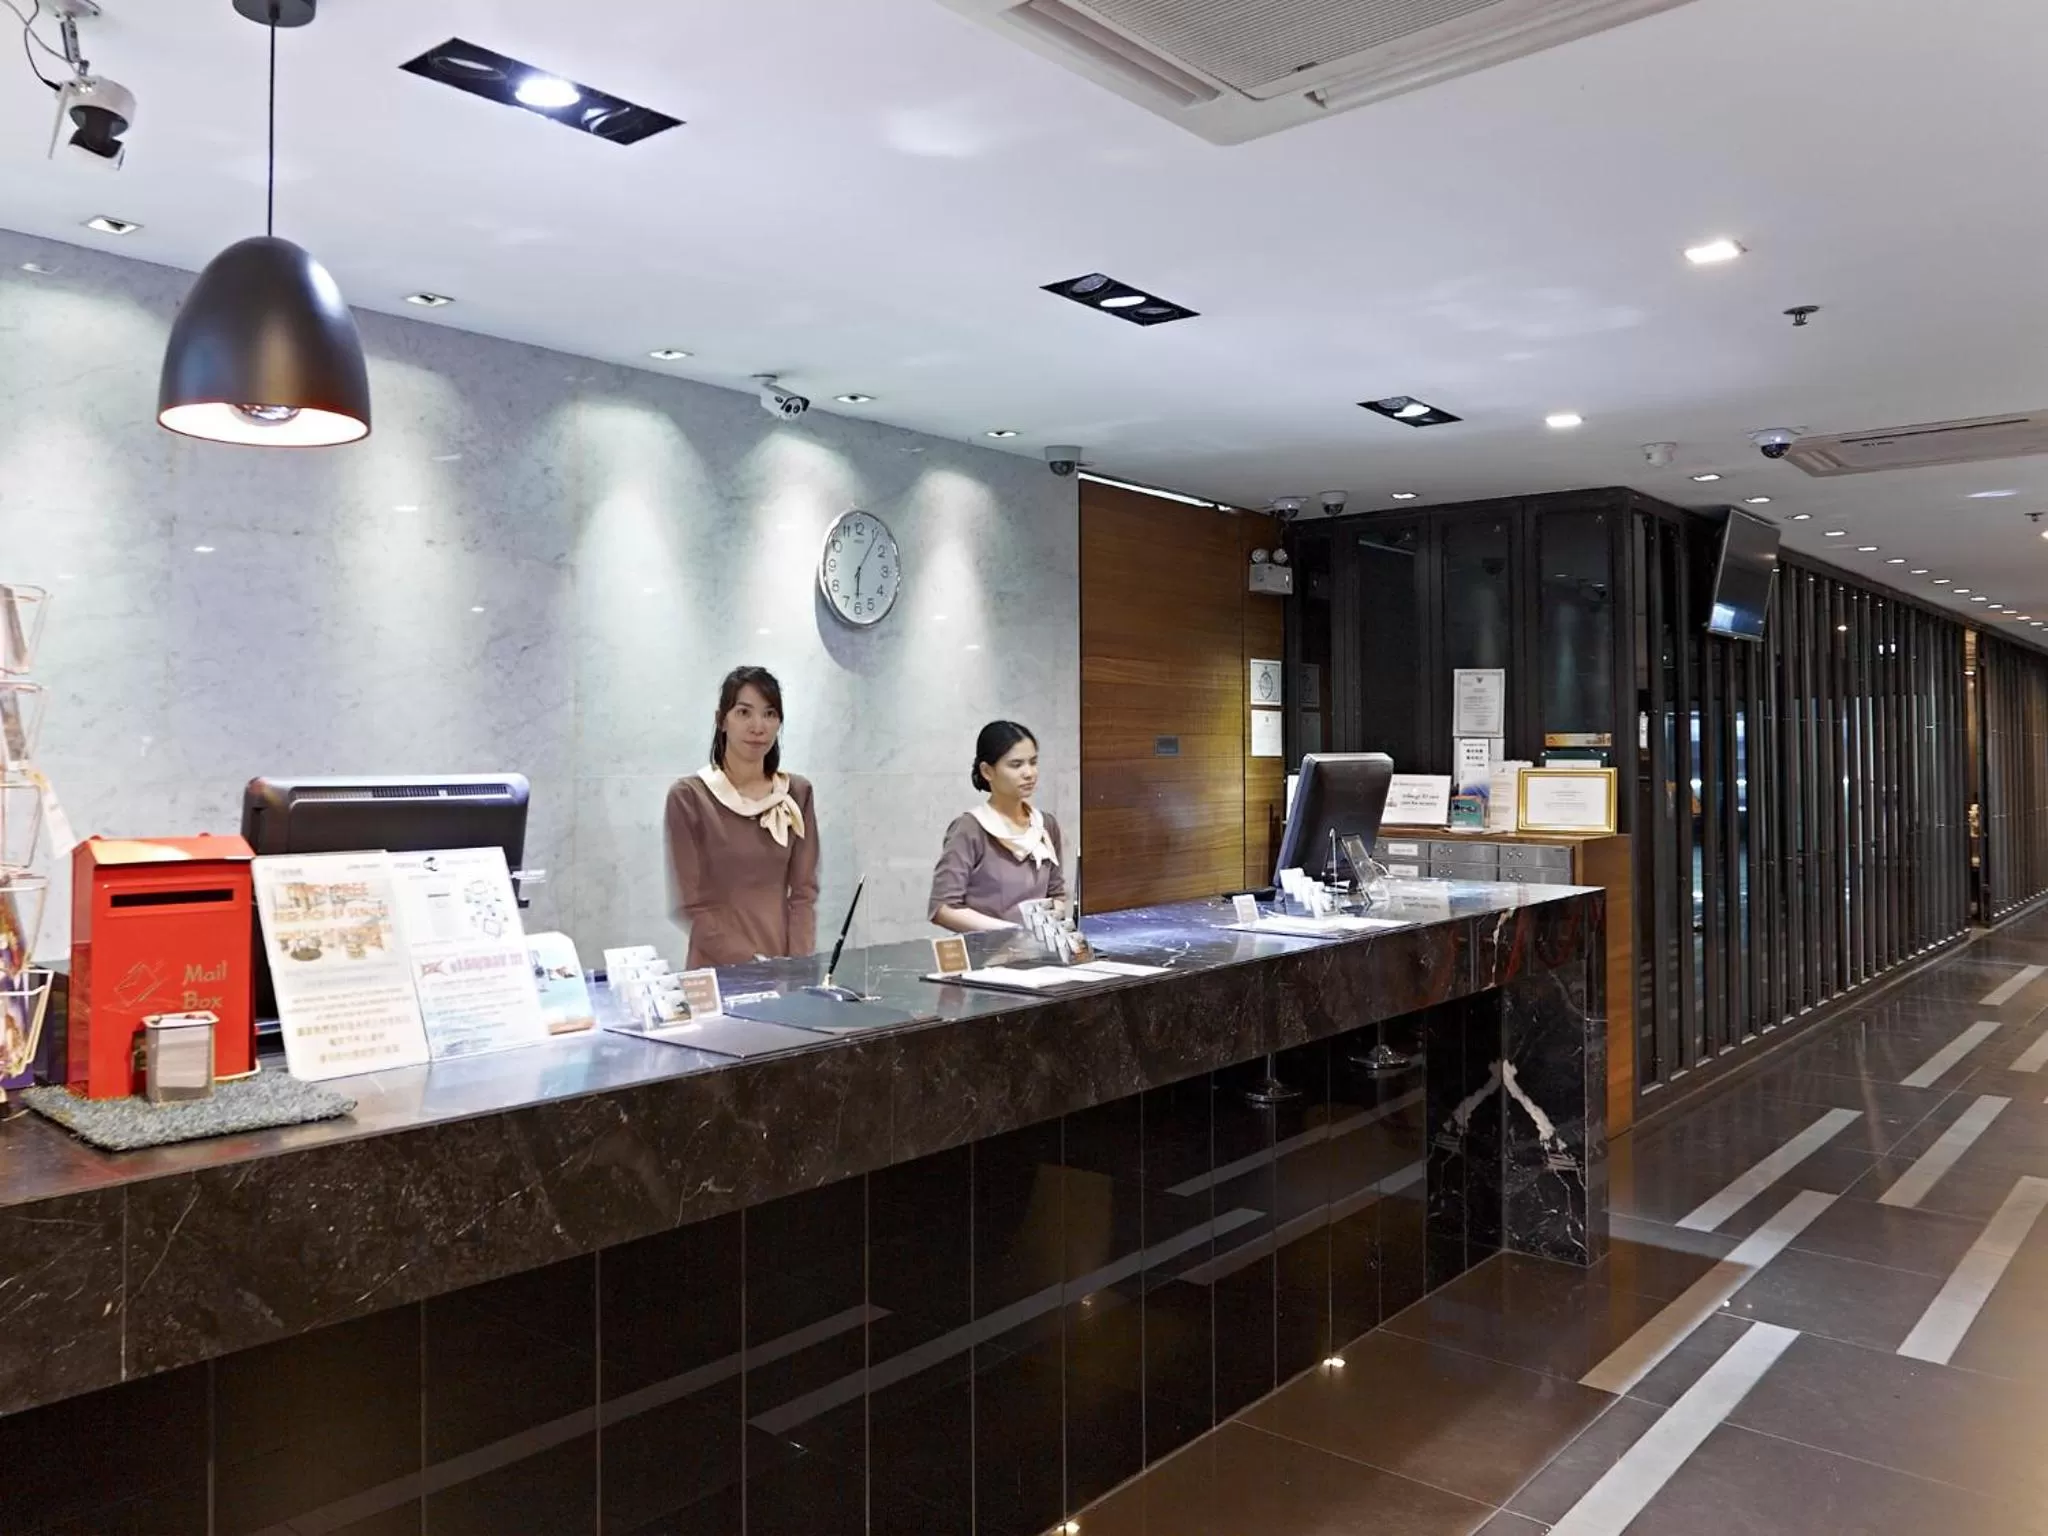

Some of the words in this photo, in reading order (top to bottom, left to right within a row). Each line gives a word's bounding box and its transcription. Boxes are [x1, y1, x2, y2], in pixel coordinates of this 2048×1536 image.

[843, 526, 850, 537] 11
[855, 521, 864, 536] 12
[877, 545, 885, 558] 2
[828, 559, 836, 571] 9
[881, 566, 889, 579] 3
[832, 580, 839, 592] 8
[877, 585, 883, 596] 4
[842, 596, 849, 608] 7
[854, 602, 861, 615] 6
[867, 598, 874, 611] 5
[181, 959, 228, 987] Mail
[181, 990, 224, 1011] Box
